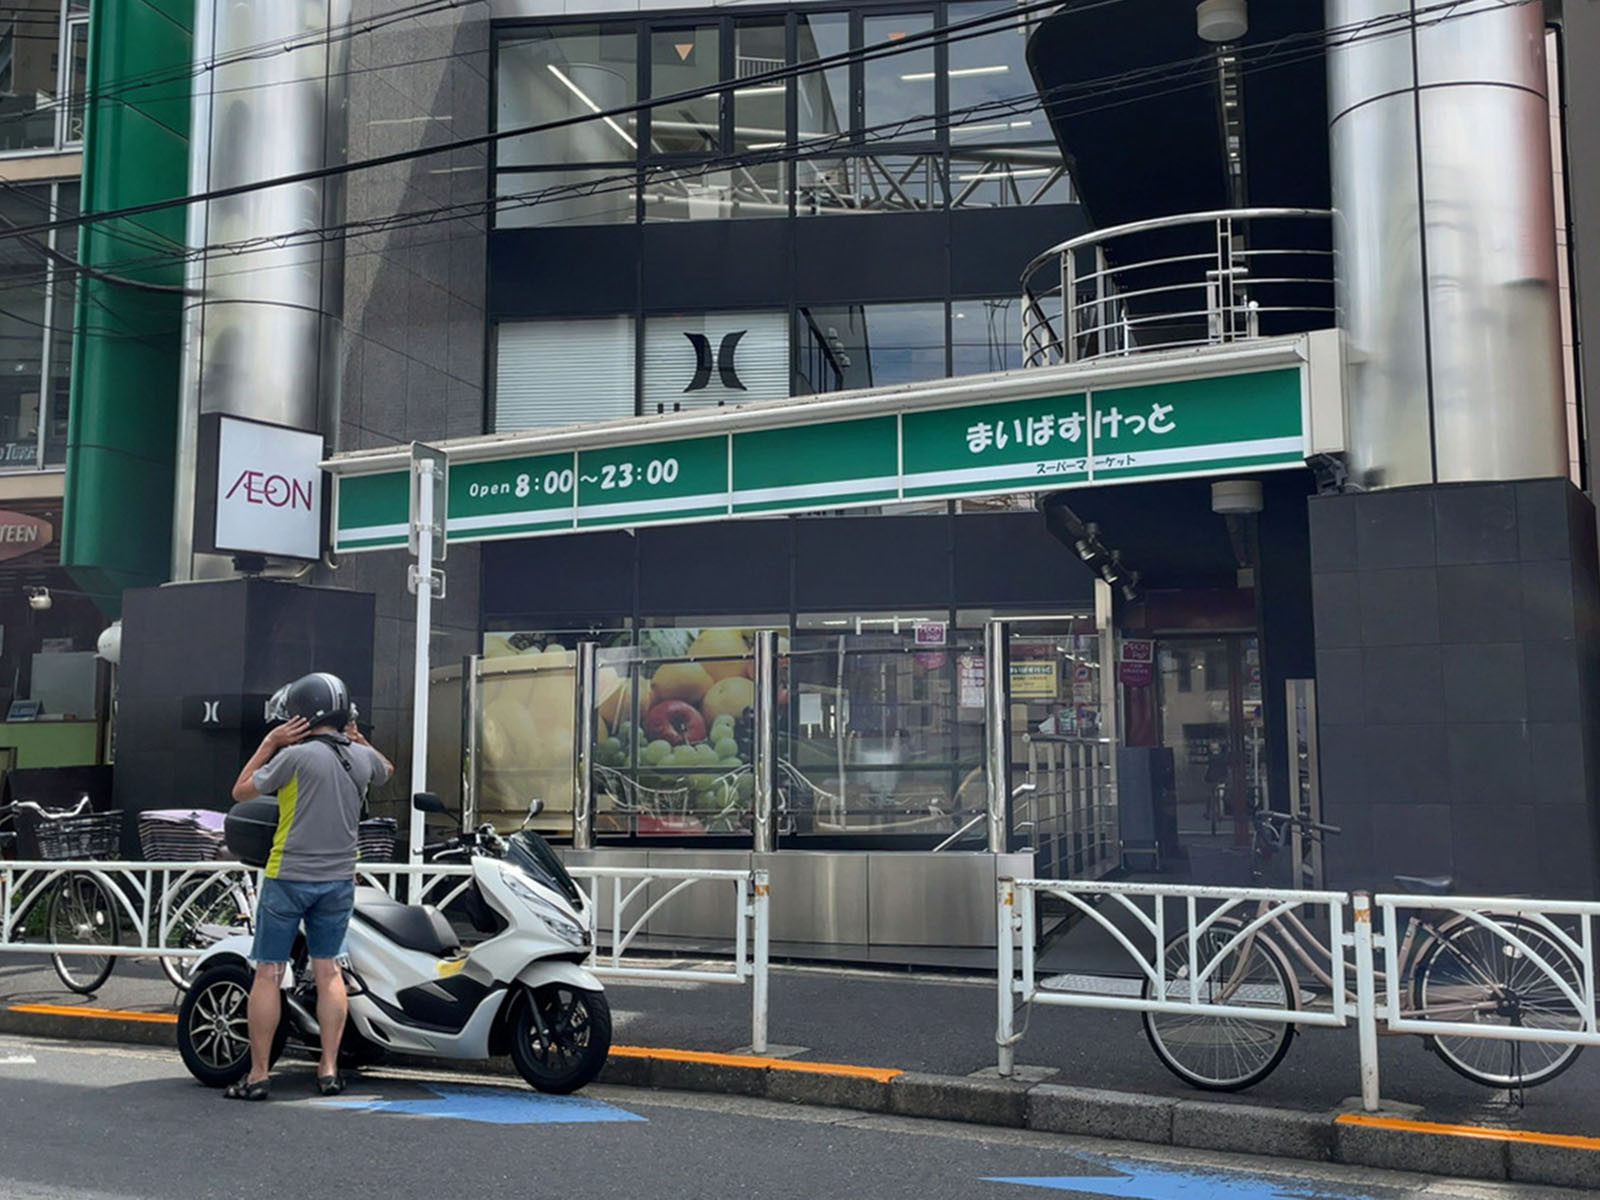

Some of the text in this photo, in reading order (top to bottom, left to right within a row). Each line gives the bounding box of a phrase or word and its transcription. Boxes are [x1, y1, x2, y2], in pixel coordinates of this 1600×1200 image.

[966, 402, 1176, 454] まいばすけっと
[1036, 454, 1136, 474] スーパーマーケット
[469, 482, 510, 498] Open
